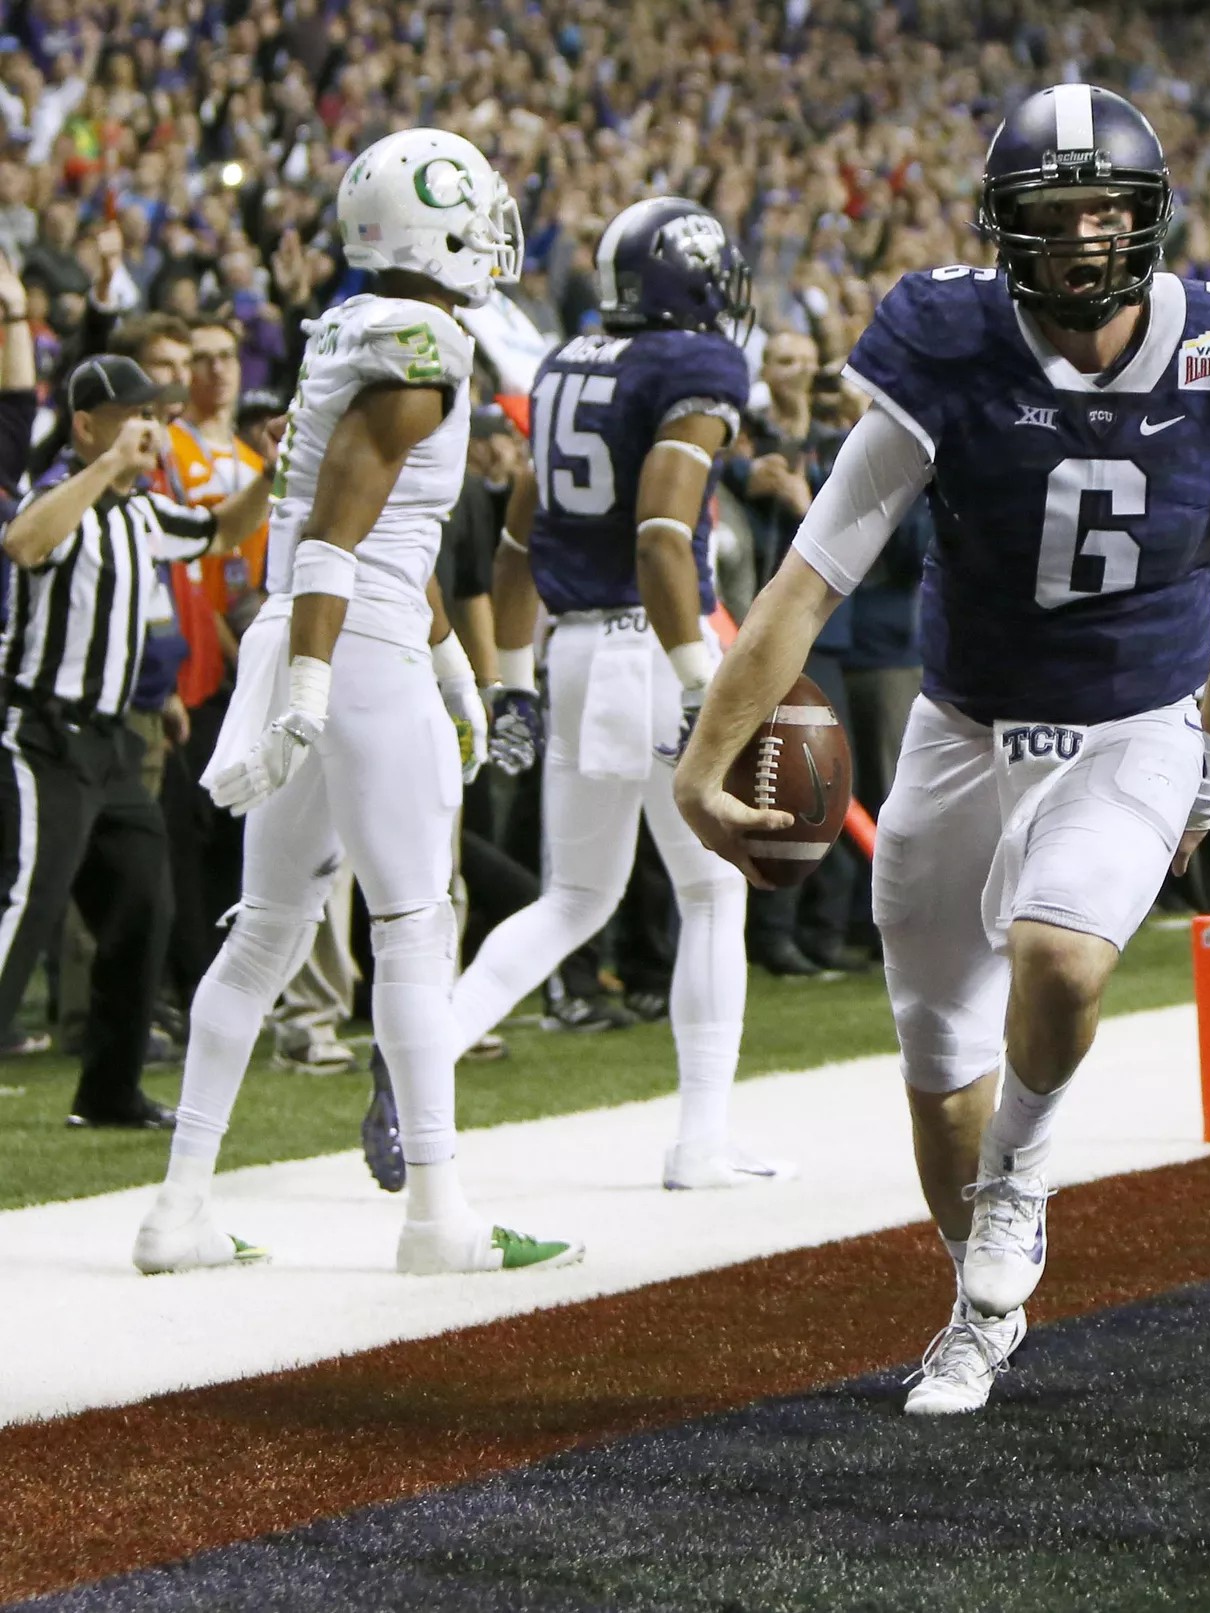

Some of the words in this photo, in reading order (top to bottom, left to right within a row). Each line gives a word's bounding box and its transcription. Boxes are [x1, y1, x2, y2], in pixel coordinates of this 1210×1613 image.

[1014, 403, 1060, 431] XII
[1088, 410, 1114, 422] TCU
[531, 371, 618, 516] 15
[1034, 458, 1148, 610] 6
[1002, 725, 1084, 765] TCU
